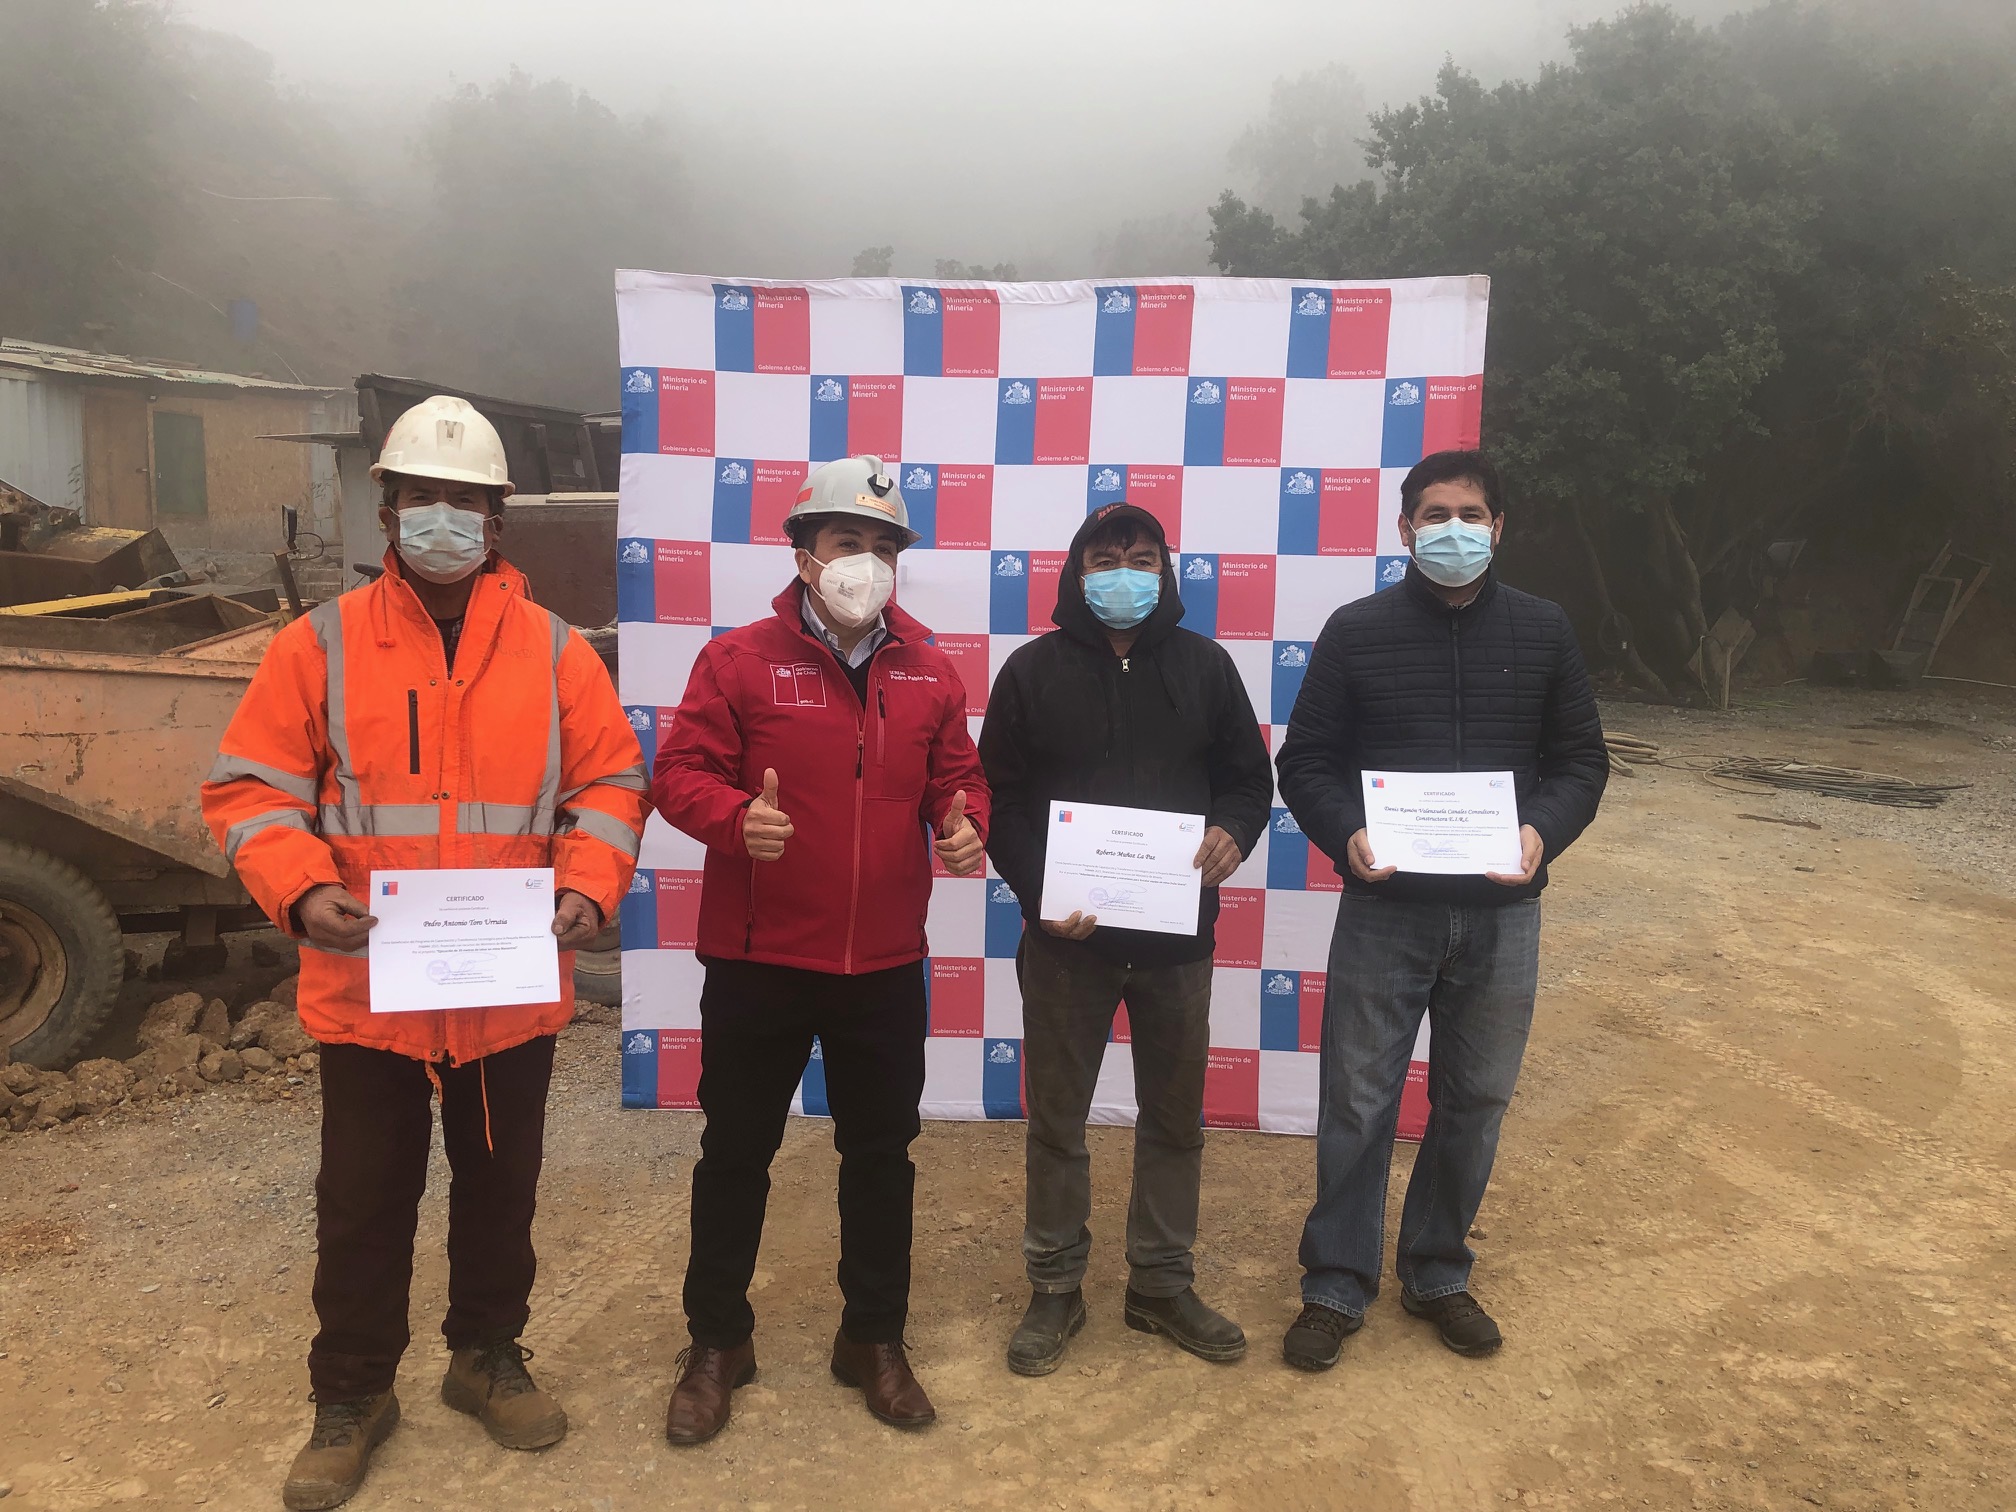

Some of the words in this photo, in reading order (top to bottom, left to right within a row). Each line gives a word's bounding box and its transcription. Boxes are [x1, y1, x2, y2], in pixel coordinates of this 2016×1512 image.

[1141, 293, 1177, 301] Ministerio
[757, 301, 784, 309] Minería
[946, 304, 973, 312] Minería
[1140, 301, 1167, 309] Minería
[1335, 305, 1363, 313] Minería
[662, 375, 698, 385] Ministerio
[662, 383, 689, 391] Minería
[852, 390, 878, 398] Minería
[1229, 393, 1257, 401] Minería
[1429, 392, 1457, 400] Minería
[756, 468, 791, 476] Ministerio
[976, 472, 986, 480] de
[1130, 472, 1166, 480] Ministerio
[1166, 473, 1176, 481] de
[1324, 476, 1361, 484] Ministerio
[941, 479, 967, 487] Minería
[1130, 480, 1157, 488] Minería
[1324, 484, 1352, 492] Minería
[658, 547, 693, 556] Ministerio
[658, 555, 684, 563] Minería
[1222, 562, 1258, 570] Ministerio
[938, 641, 972, 649] Ministerio
[940, 648, 964, 656] inería
[1111, 830, 1144, 838] CERTIFICADO
[1145, 853, 1156, 861] Paz
[659, 883, 685, 891] Minería
[1219, 894, 1248, 903] inisterio
[441, 919, 468, 927] Antonio
[484, 918, 508, 926] Urrutia
[934, 964, 968, 972] Ministerio
[1303, 979, 1326, 987] Minist
[1302, 986, 1326, 994] Minerí
[1207, 1055, 1242, 1063] Ministerio
[1207, 1062, 1233, 1070] Minería
